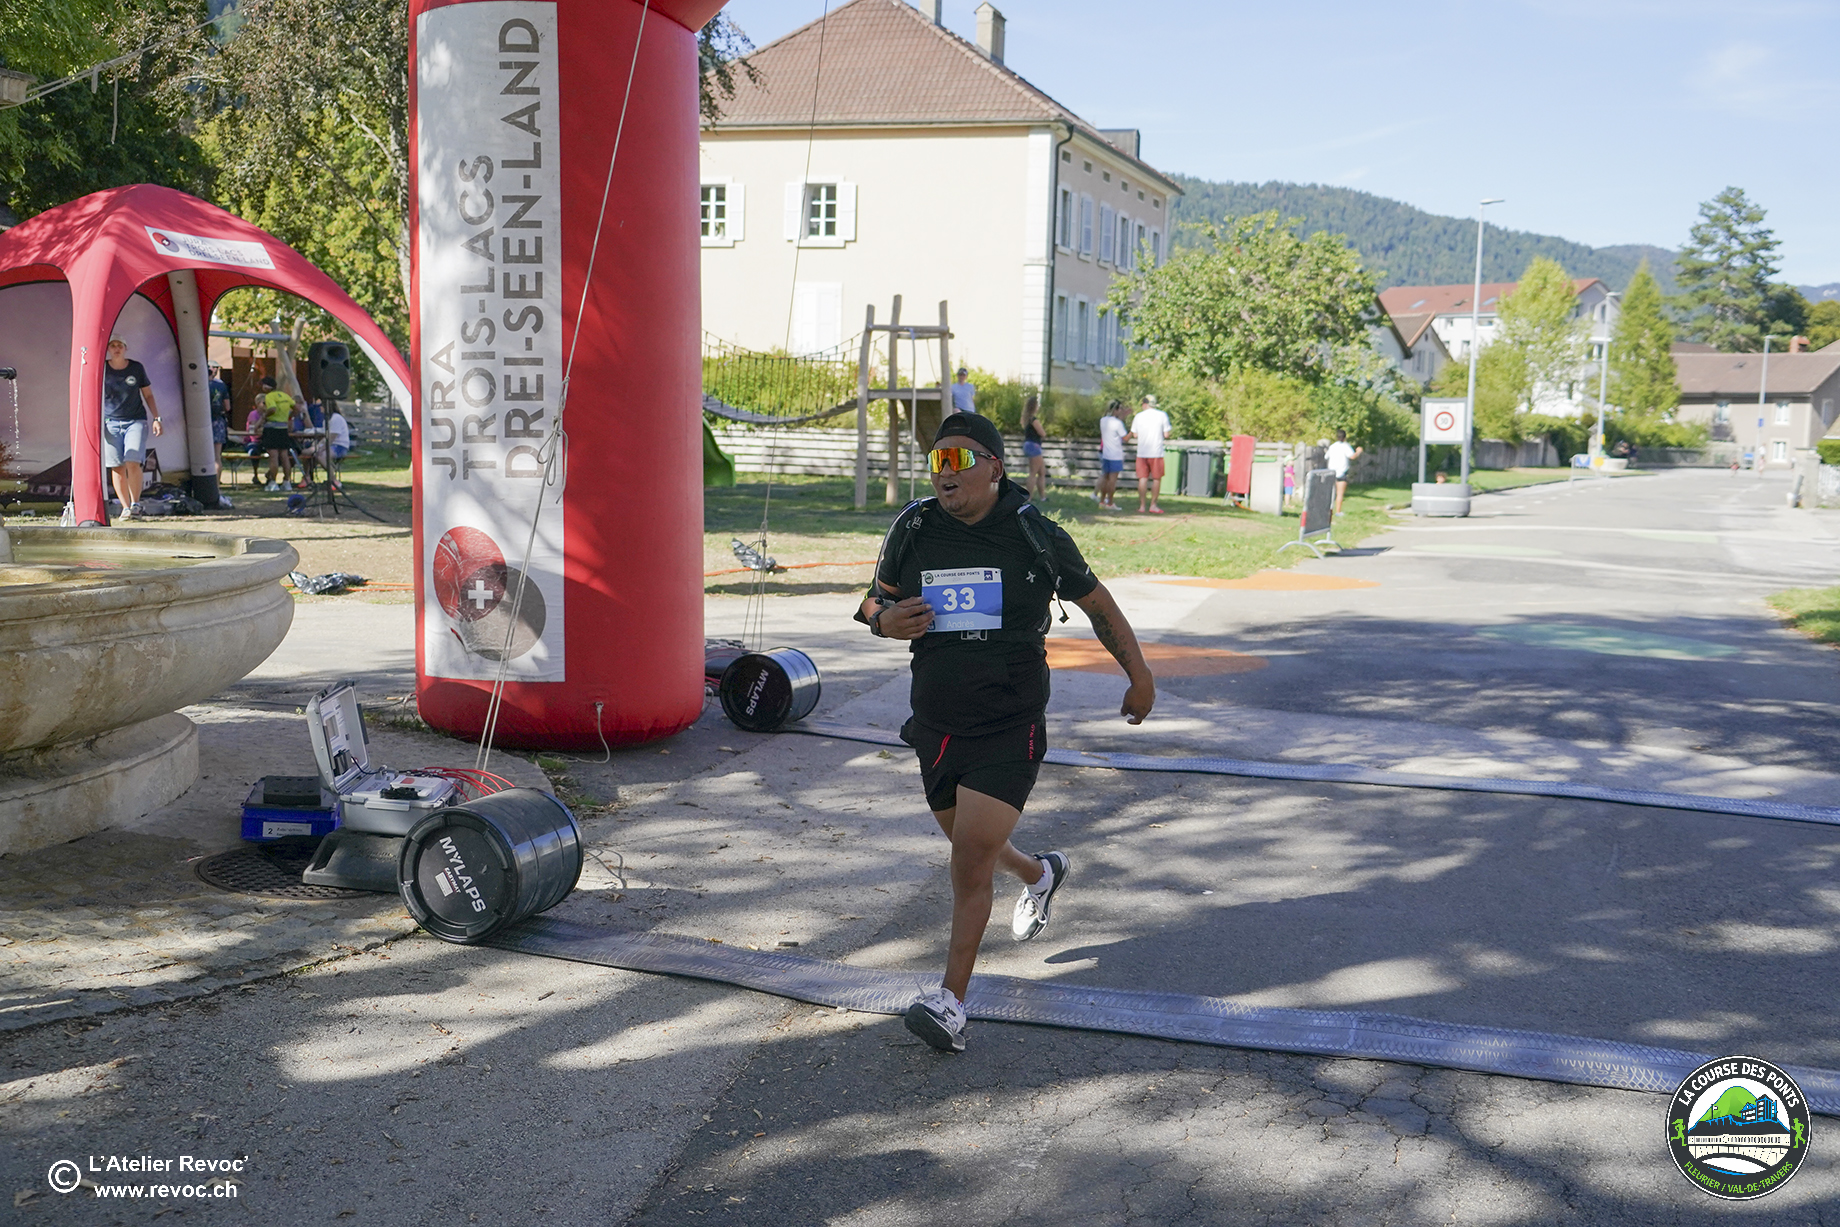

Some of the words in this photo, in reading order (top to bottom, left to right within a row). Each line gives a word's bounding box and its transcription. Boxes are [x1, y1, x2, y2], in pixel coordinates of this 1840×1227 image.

[498, 18, 544, 478] DREI-SEEN-LAND
[458, 154, 496, 480] TROIS-LACS
[430, 340, 457, 480] JURA
[942, 587, 976, 611] 33
[946, 620, 975, 628] Andrès
[745, 669, 769, 716] MYLAPS
[267, 827, 273, 835] 2
[439, 836, 487, 912] MYLAPS
